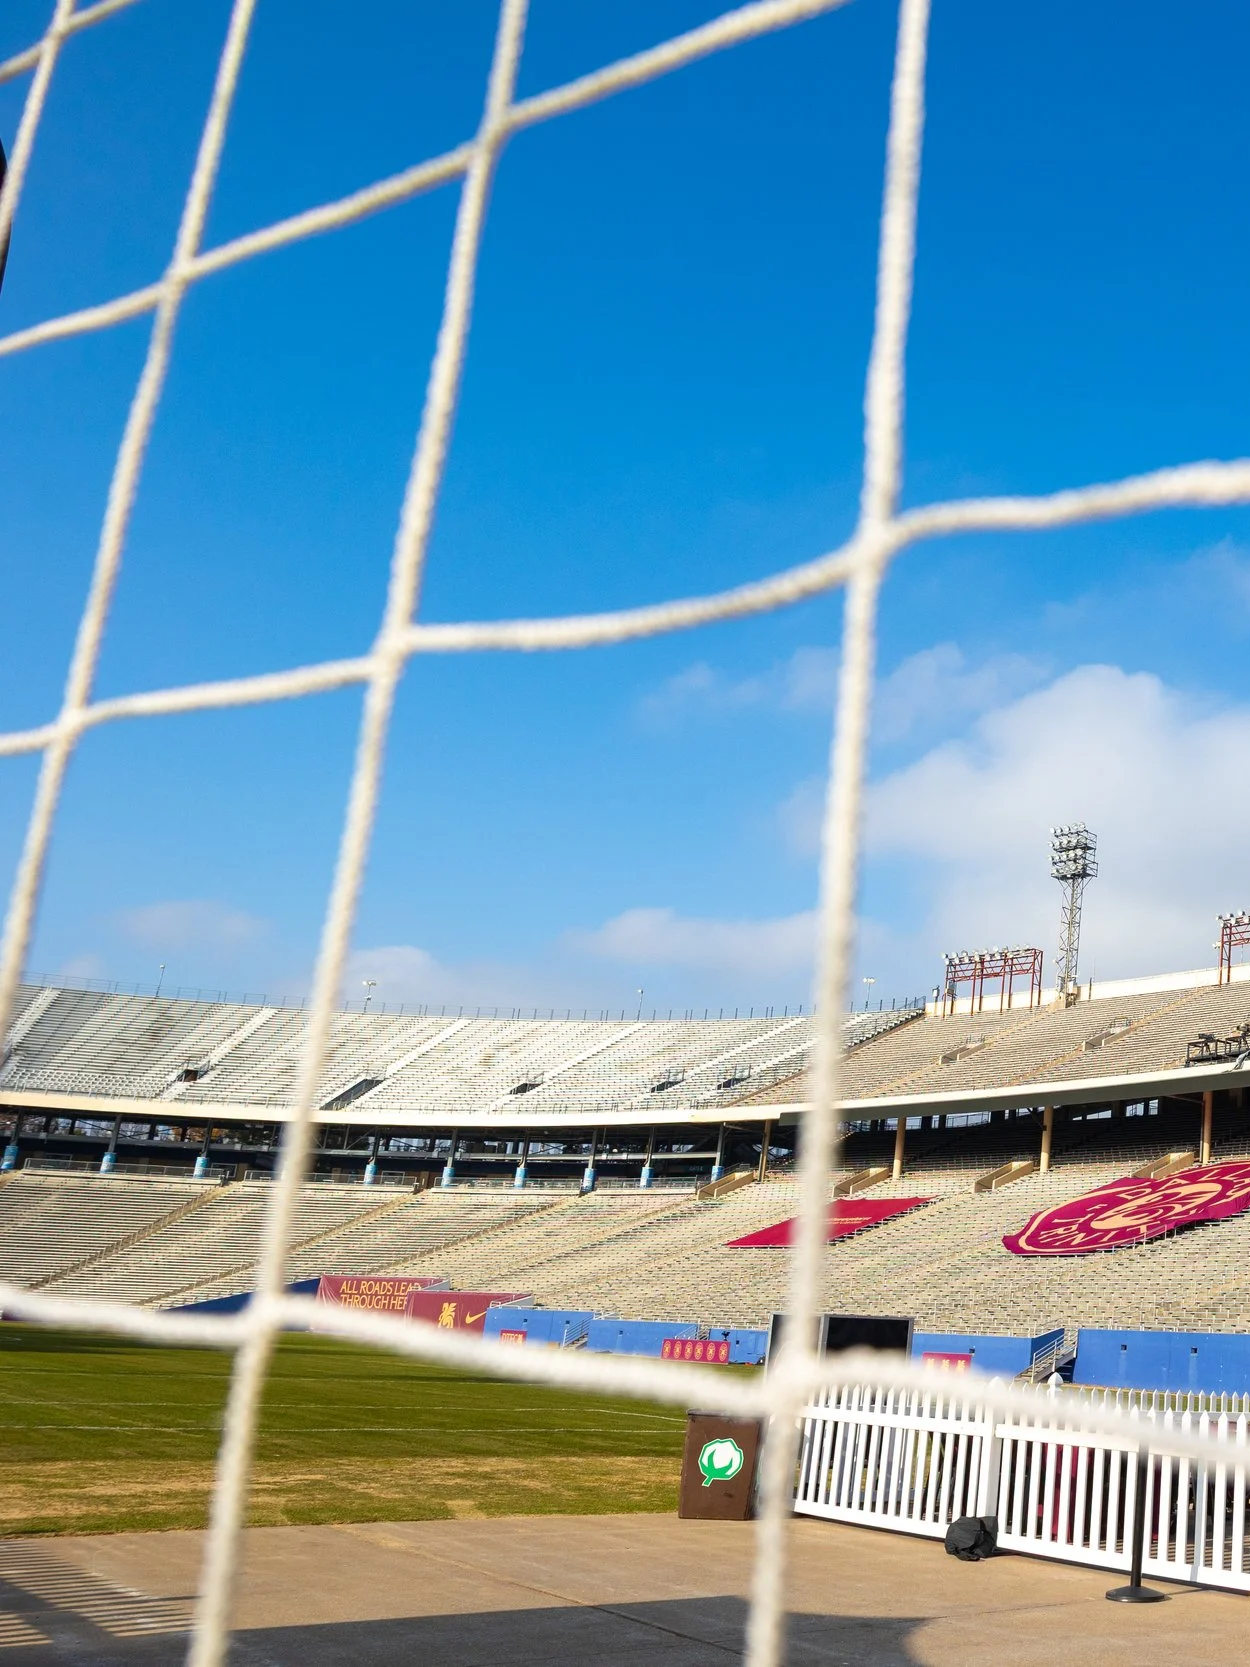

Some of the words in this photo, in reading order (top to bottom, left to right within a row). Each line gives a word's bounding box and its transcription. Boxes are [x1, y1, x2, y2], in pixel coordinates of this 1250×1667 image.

[340, 1280, 358, 1294] ALL
[360, 1281, 393, 1295] ROADS
[340, 1294, 389, 1309] THROUGH
